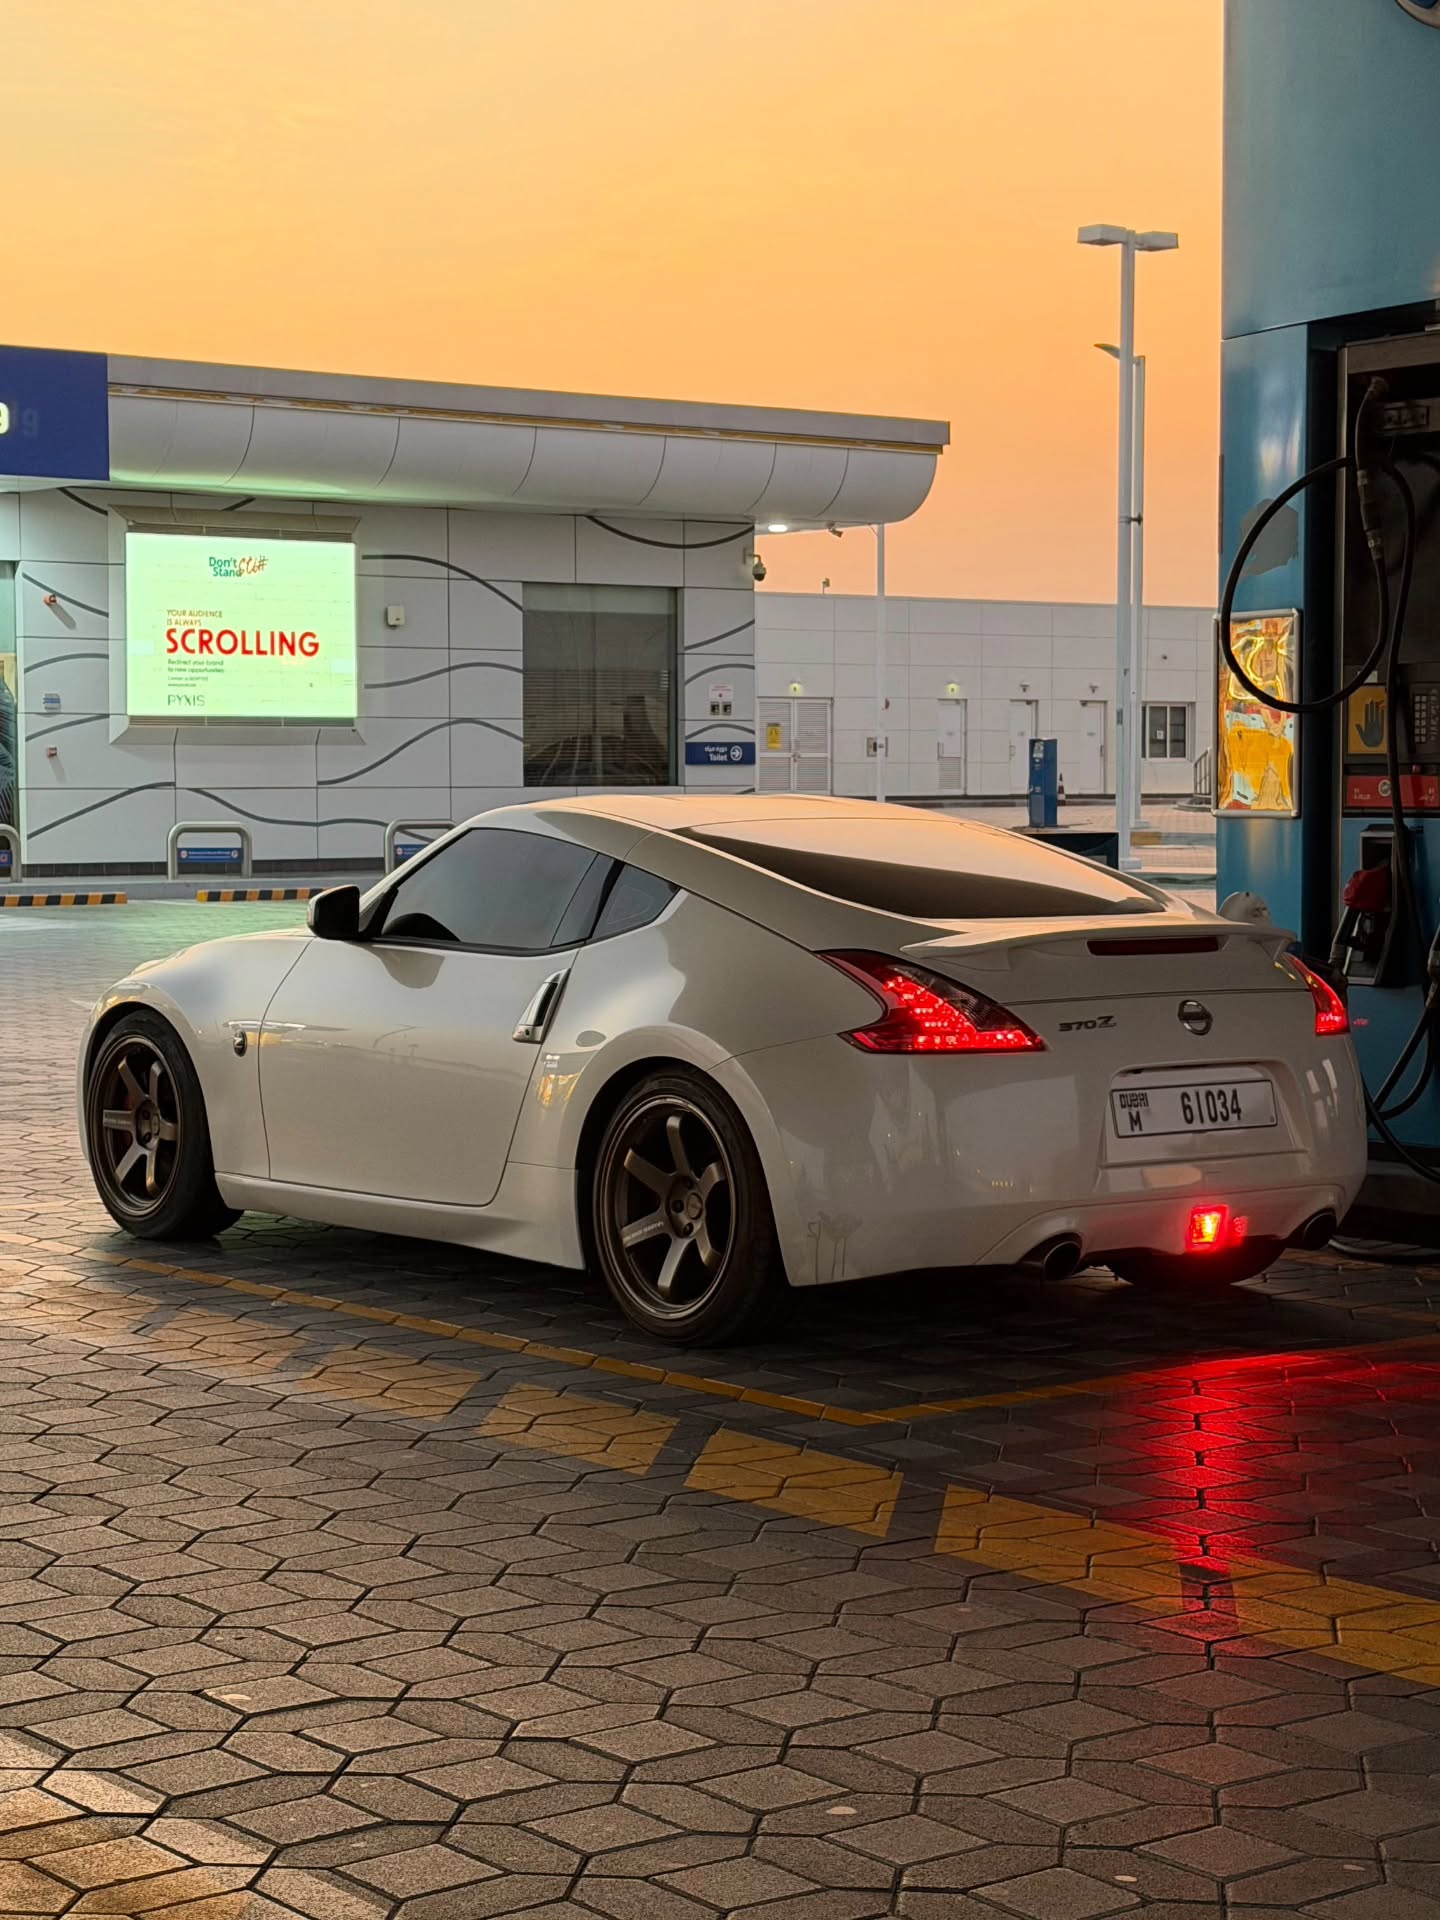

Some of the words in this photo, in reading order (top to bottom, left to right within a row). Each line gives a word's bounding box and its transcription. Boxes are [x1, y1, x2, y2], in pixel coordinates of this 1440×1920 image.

[209, 556, 237, 568] Don't
[213, 567, 242, 577] Stand
[166, 609, 186, 617] YOUR
[189, 610, 223, 618] AUDIENCE
[166, 628, 319, 657] SCROLLING
[168, 694, 206, 706] PYXIS
[709, 753, 728, 761] Toilet
[1058, 1015, 1117, 1032] 370Z
[1180, 1088, 1242, 1125] 61034
[1128, 1111, 1143, 1132] M
